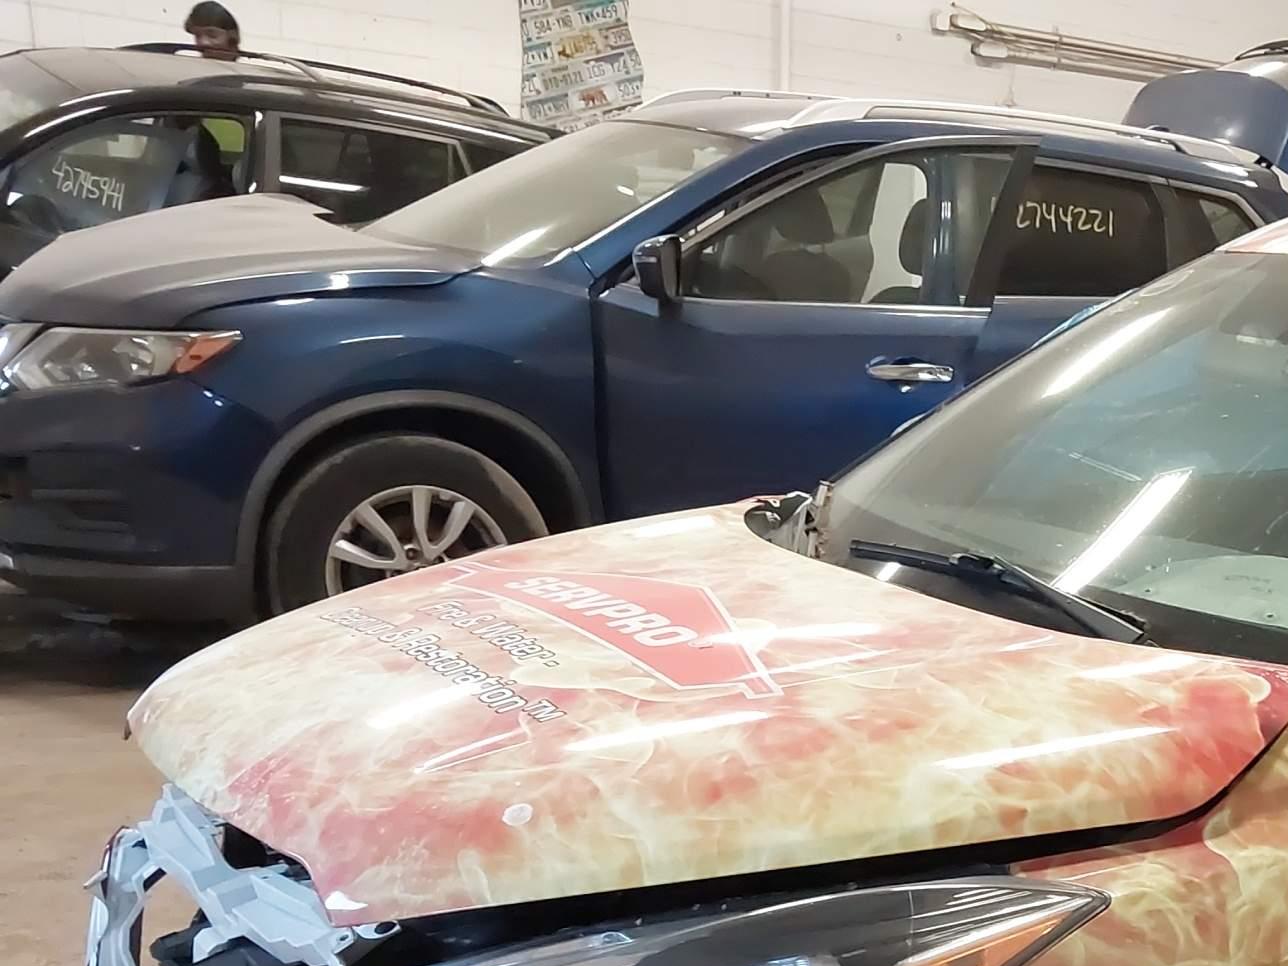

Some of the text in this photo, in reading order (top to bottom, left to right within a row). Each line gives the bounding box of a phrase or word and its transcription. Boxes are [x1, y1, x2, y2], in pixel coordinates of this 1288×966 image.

[989, 196, 1114, 238] 2744221
[503, 575, 699, 648] SERVPRO
[469, 620, 557, 661] Water
